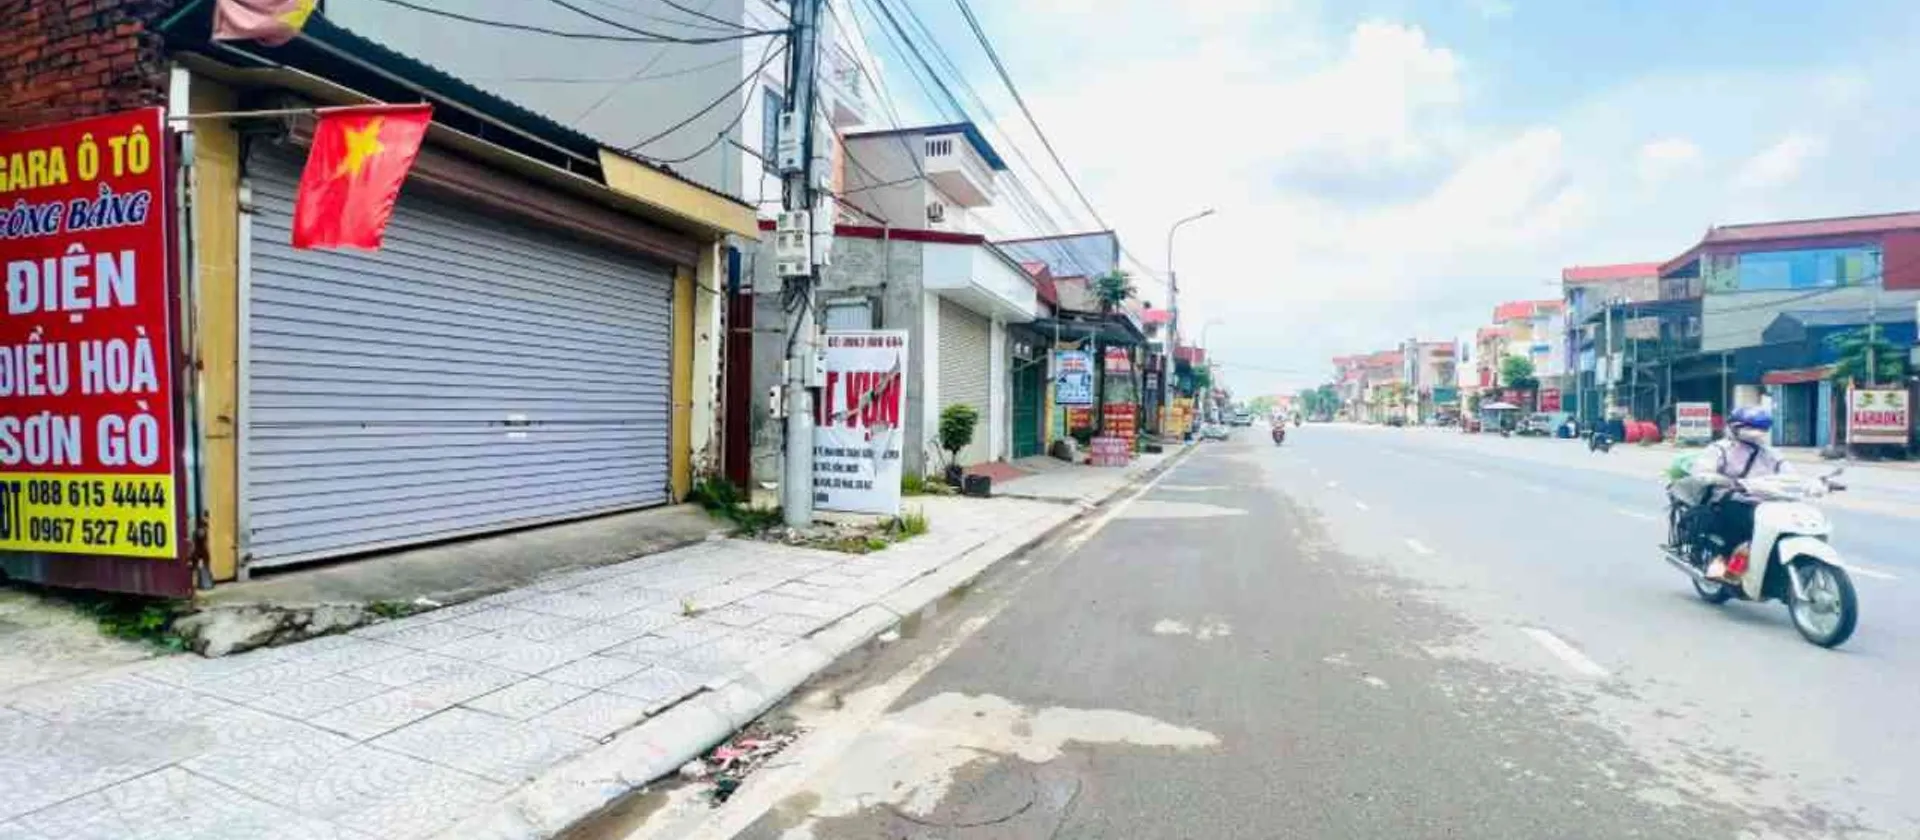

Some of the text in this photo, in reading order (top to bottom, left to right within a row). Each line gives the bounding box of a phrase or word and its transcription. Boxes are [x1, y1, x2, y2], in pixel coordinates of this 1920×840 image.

[77, 132, 99, 181] Ô
[108, 124, 151, 177] TÔ
[67, 181, 151, 231] BẰNG
[6, 243, 136, 323] ĐIỆN
[80, 326, 158, 394] HOÀ
[0, 400, 158, 466] SƠN GÒ
[1854, 410, 1905, 427] KARAOKE
[28, 480, 61, 505] 088
[68, 481, 104, 507] 615
[113, 482, 165, 508] 4444
[29, 518, 167, 547] 0967 527 460
